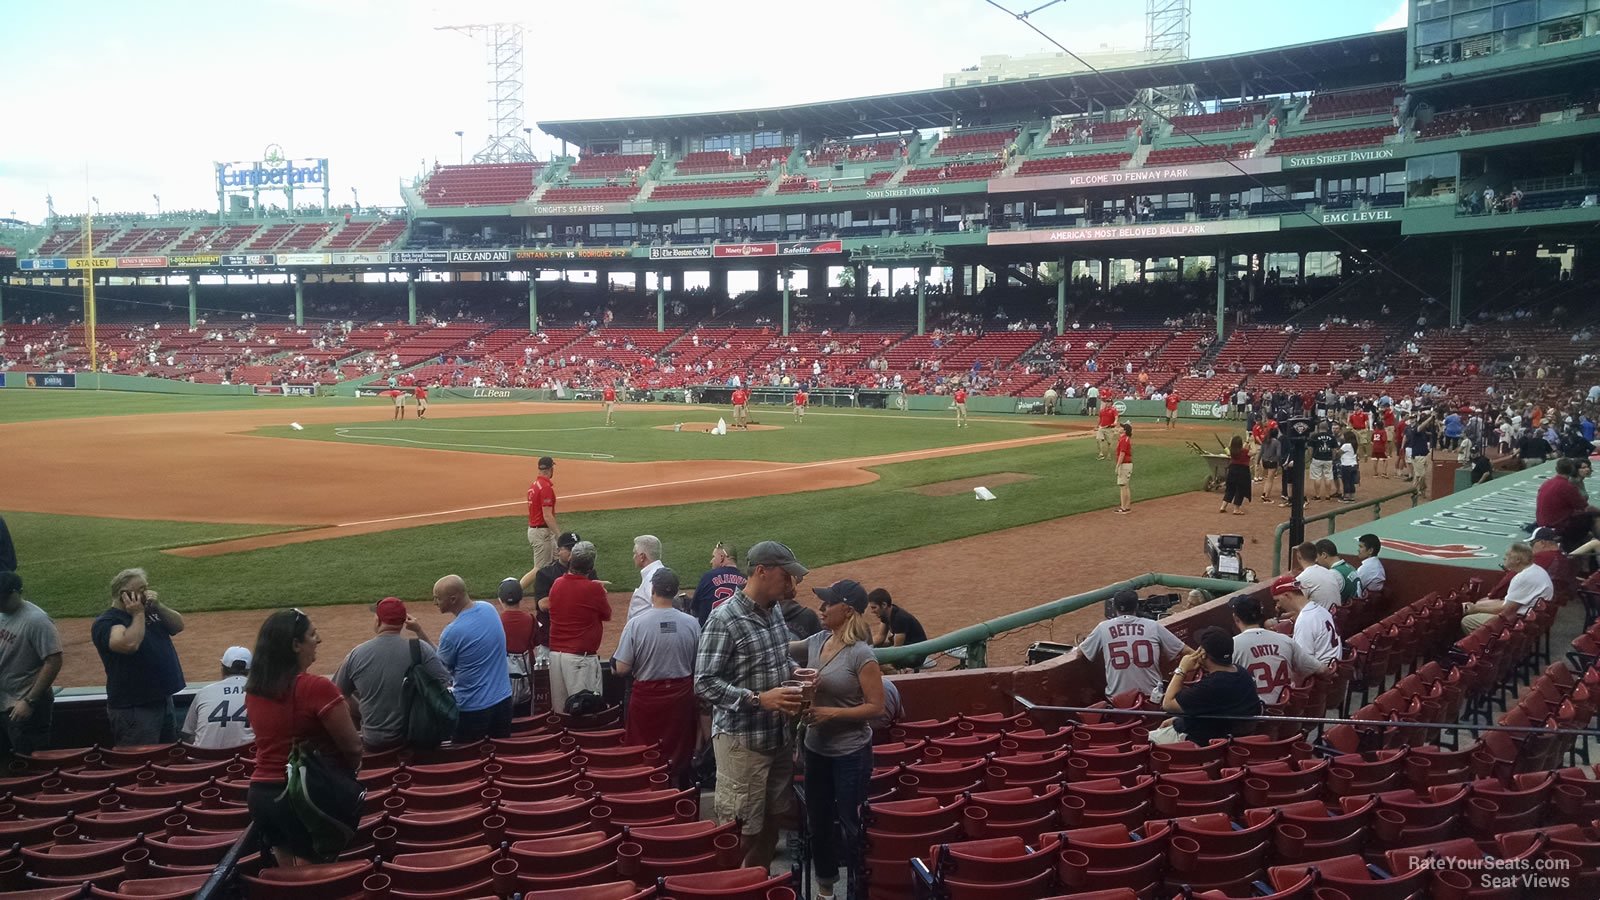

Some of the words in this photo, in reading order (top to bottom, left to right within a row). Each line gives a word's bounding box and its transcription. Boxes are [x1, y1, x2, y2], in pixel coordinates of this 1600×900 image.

[1290, 157, 1315, 167] STATE
[1316, 154, 1347, 165] STREET
[1350, 149, 1394, 161] PAVILION
[219, 159, 323, 186] Cumberland
[1069, 175, 1109, 185] WELCOME
[1111, 173, 1122, 182] TO
[1125, 170, 1161, 181] FENWAY
[1164, 168, 1189, 178] PARK
[866, 190, 884, 199] STATE
[885, 188, 907, 198] STREET
[909, 186, 940, 196] PAVILION
[533, 205, 567, 214] TONIGHT'S
[569, 204, 604, 213] STARTERS
[1322, 213, 1349, 223] EMC
[1353, 210, 1393, 221] LEVEL
[1050, 230, 1092, 241] AMERICA'S
[1094, 228, 1117, 239] MOST
[1119, 227, 1158, 238] BELOVED
[1159, 225, 1206, 235] BALLPARK
[453, 252, 472, 261] ALEX
[474, 252, 491, 261] AND
[493, 252, 507, 260] ANI
[516, 251, 549, 259] QUINTANA
[578, 249, 613, 258] RODRIGUEZ
[662, 249, 673, 257] The
[673, 248, 692, 257] Boston
[783, 246, 811, 254] Safelite
[1191, 403, 1212, 411] Ninety
[1108, 623, 1145, 639] BETTS
[1107, 639, 1155, 670] 50
[1250, 644, 1280, 659] ORTIZ
[1247, 659, 1291, 694] 34
[207, 700, 249, 728] 44
